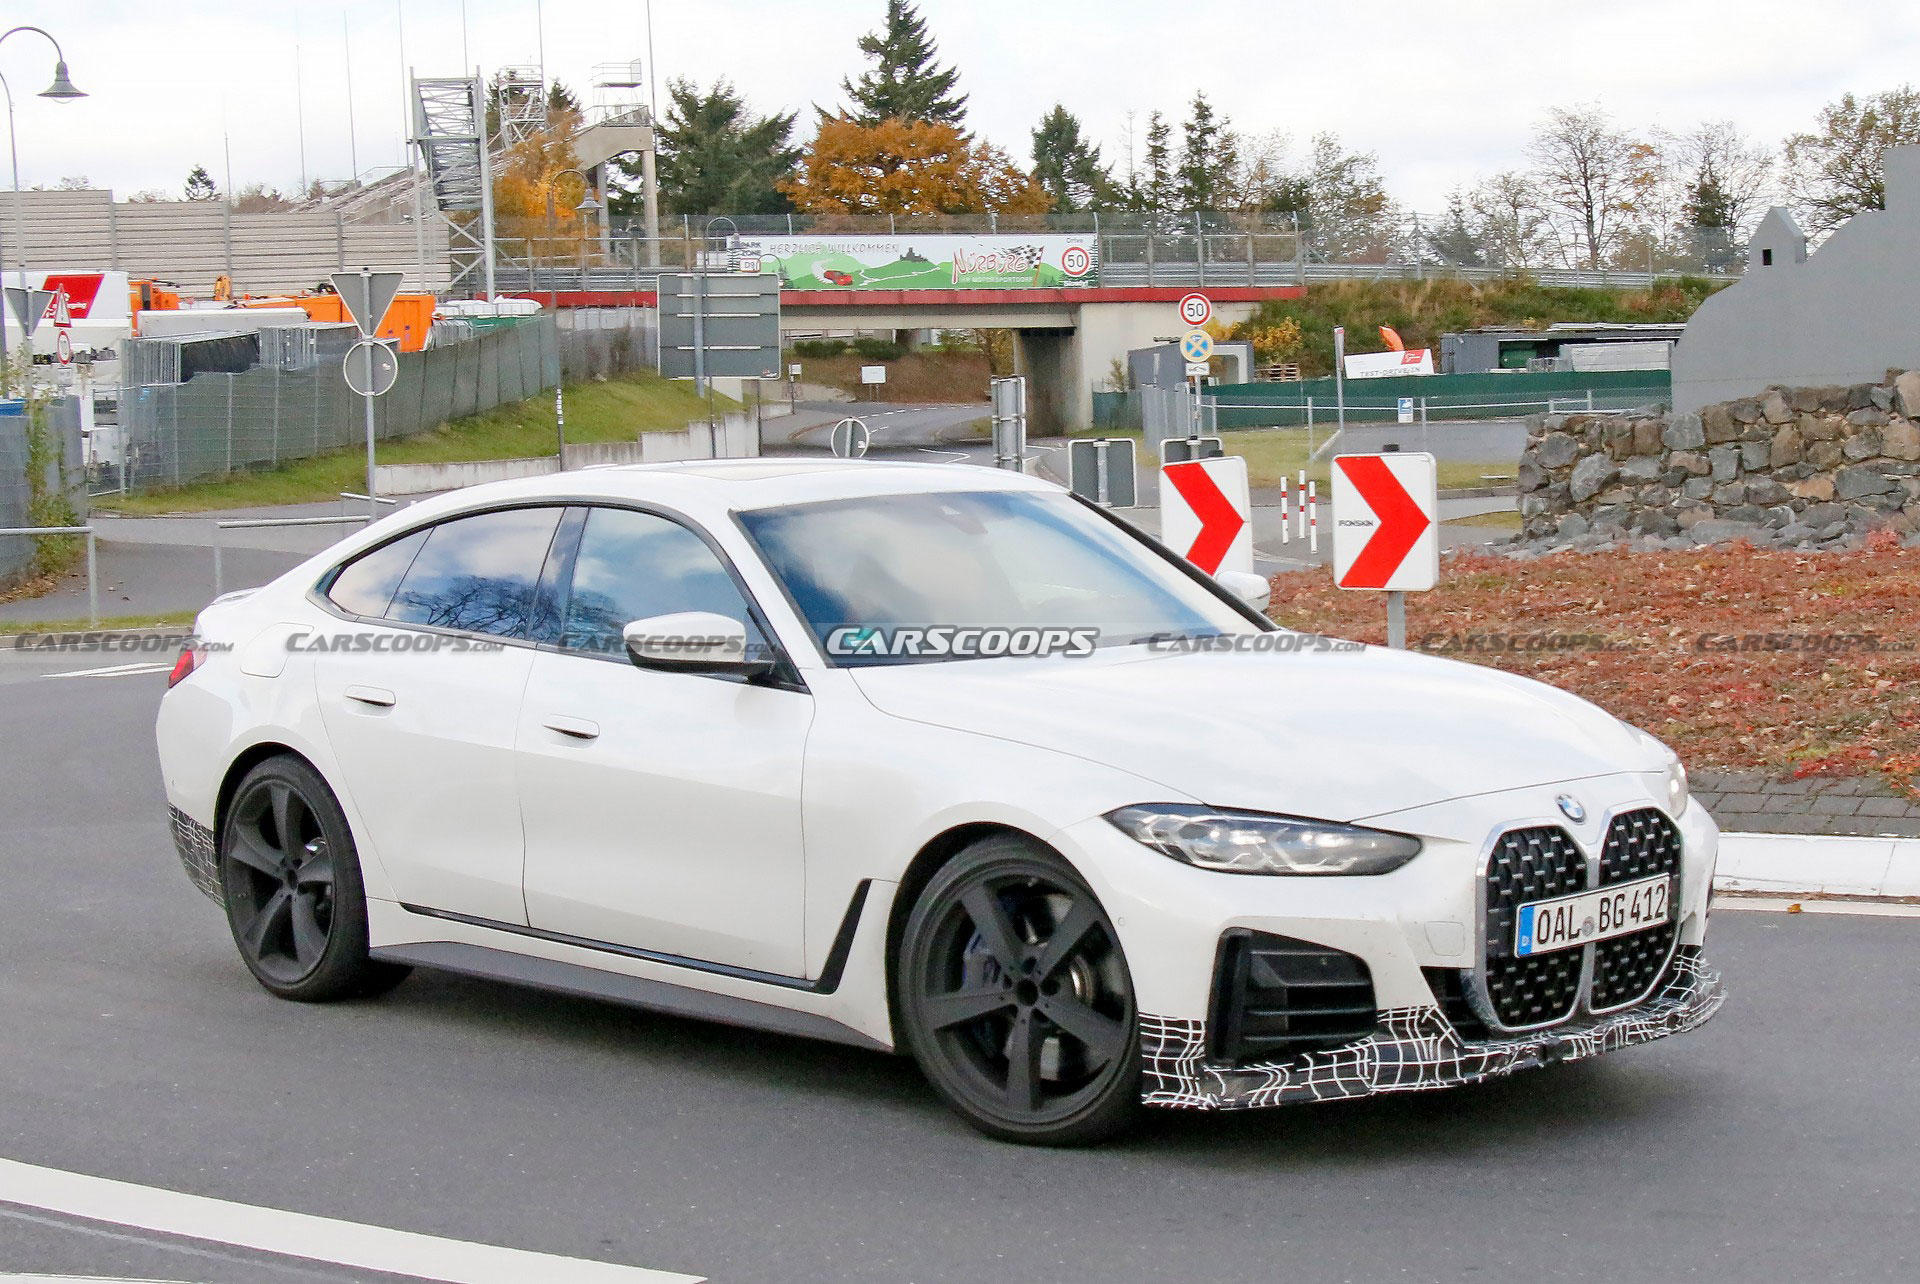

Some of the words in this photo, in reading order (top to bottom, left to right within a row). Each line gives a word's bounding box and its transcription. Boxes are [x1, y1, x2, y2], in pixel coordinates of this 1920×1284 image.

[1067, 254, 1084, 268] 50
[1187, 303, 1205, 317] 50
[1536, 904, 1582, 945] OAL
[1599, 893, 1625, 933] BG
[1630, 883, 1666, 923] 412
